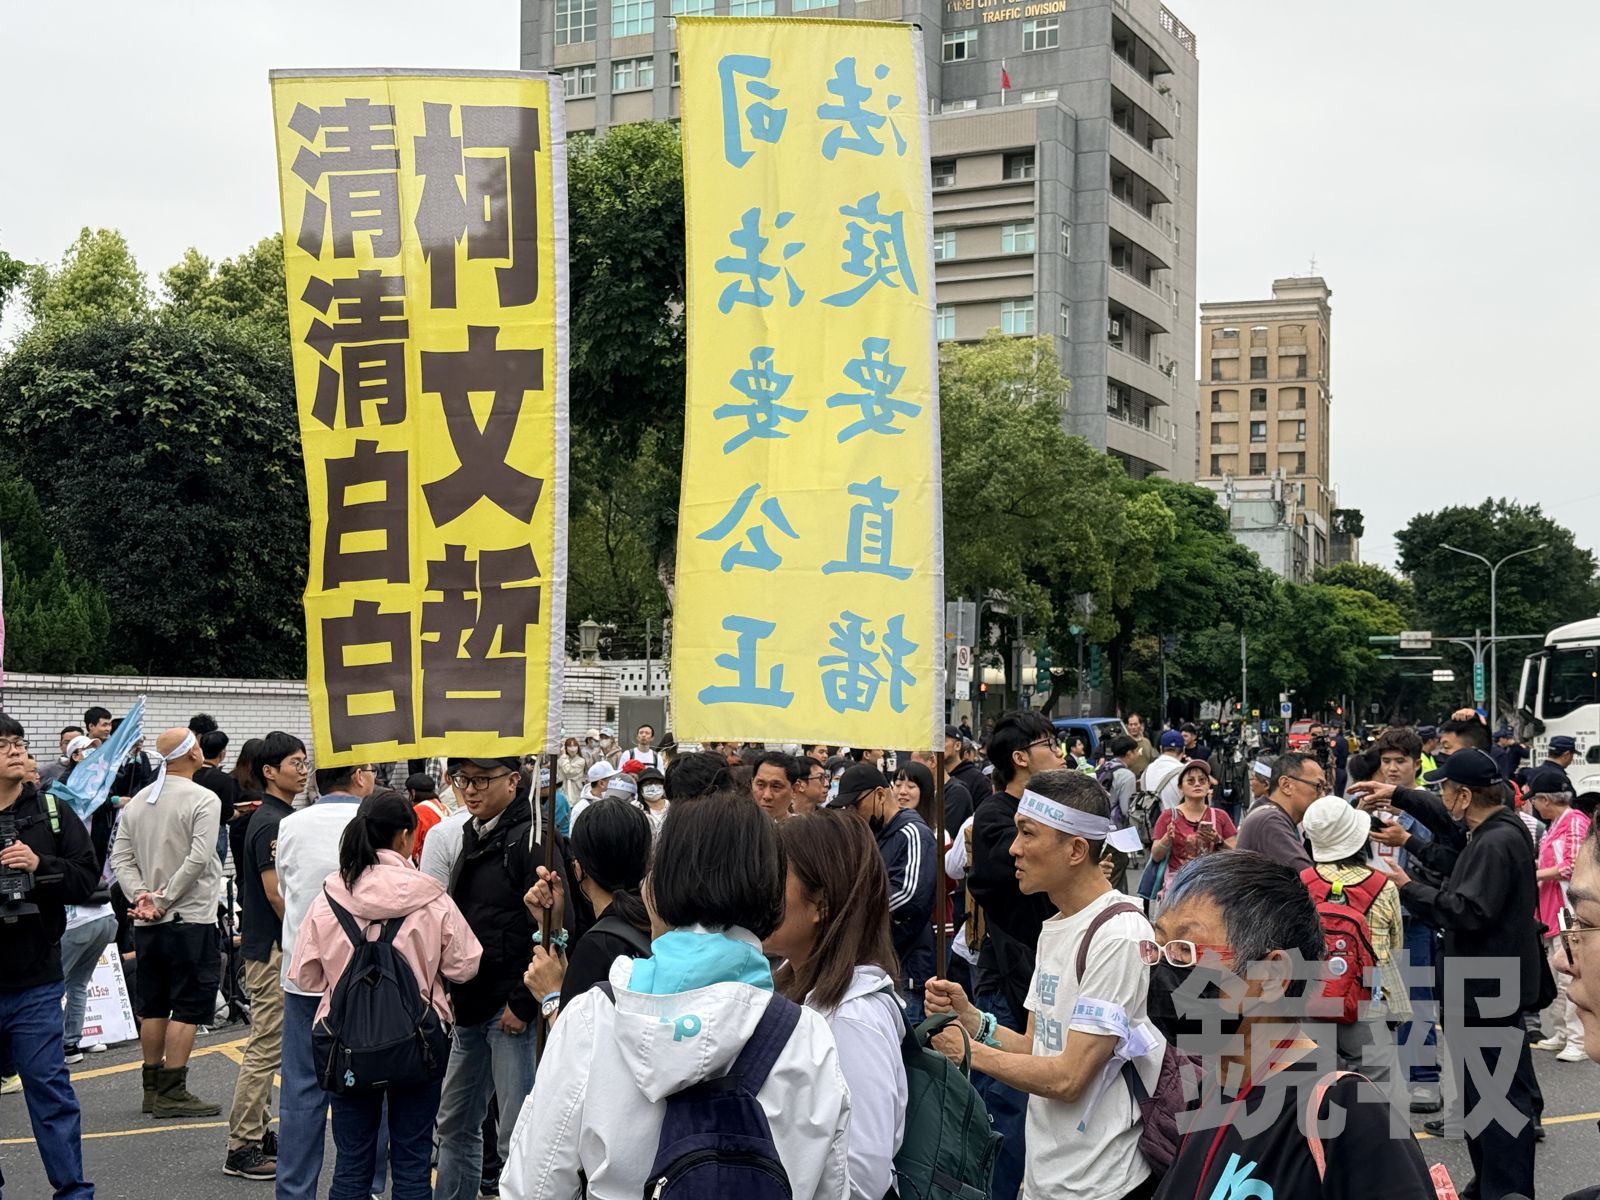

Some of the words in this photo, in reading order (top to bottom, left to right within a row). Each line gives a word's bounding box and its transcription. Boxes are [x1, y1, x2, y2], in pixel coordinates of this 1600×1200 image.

[947, 0, 974, 13] TAIPEI
[982, 9, 1021, 24] TRAFFIC
[1025, 1, 1066, 18] DIVISION
[288, 97, 416, 753] 清清白白
[414, 100, 544, 739] 柯文哲
